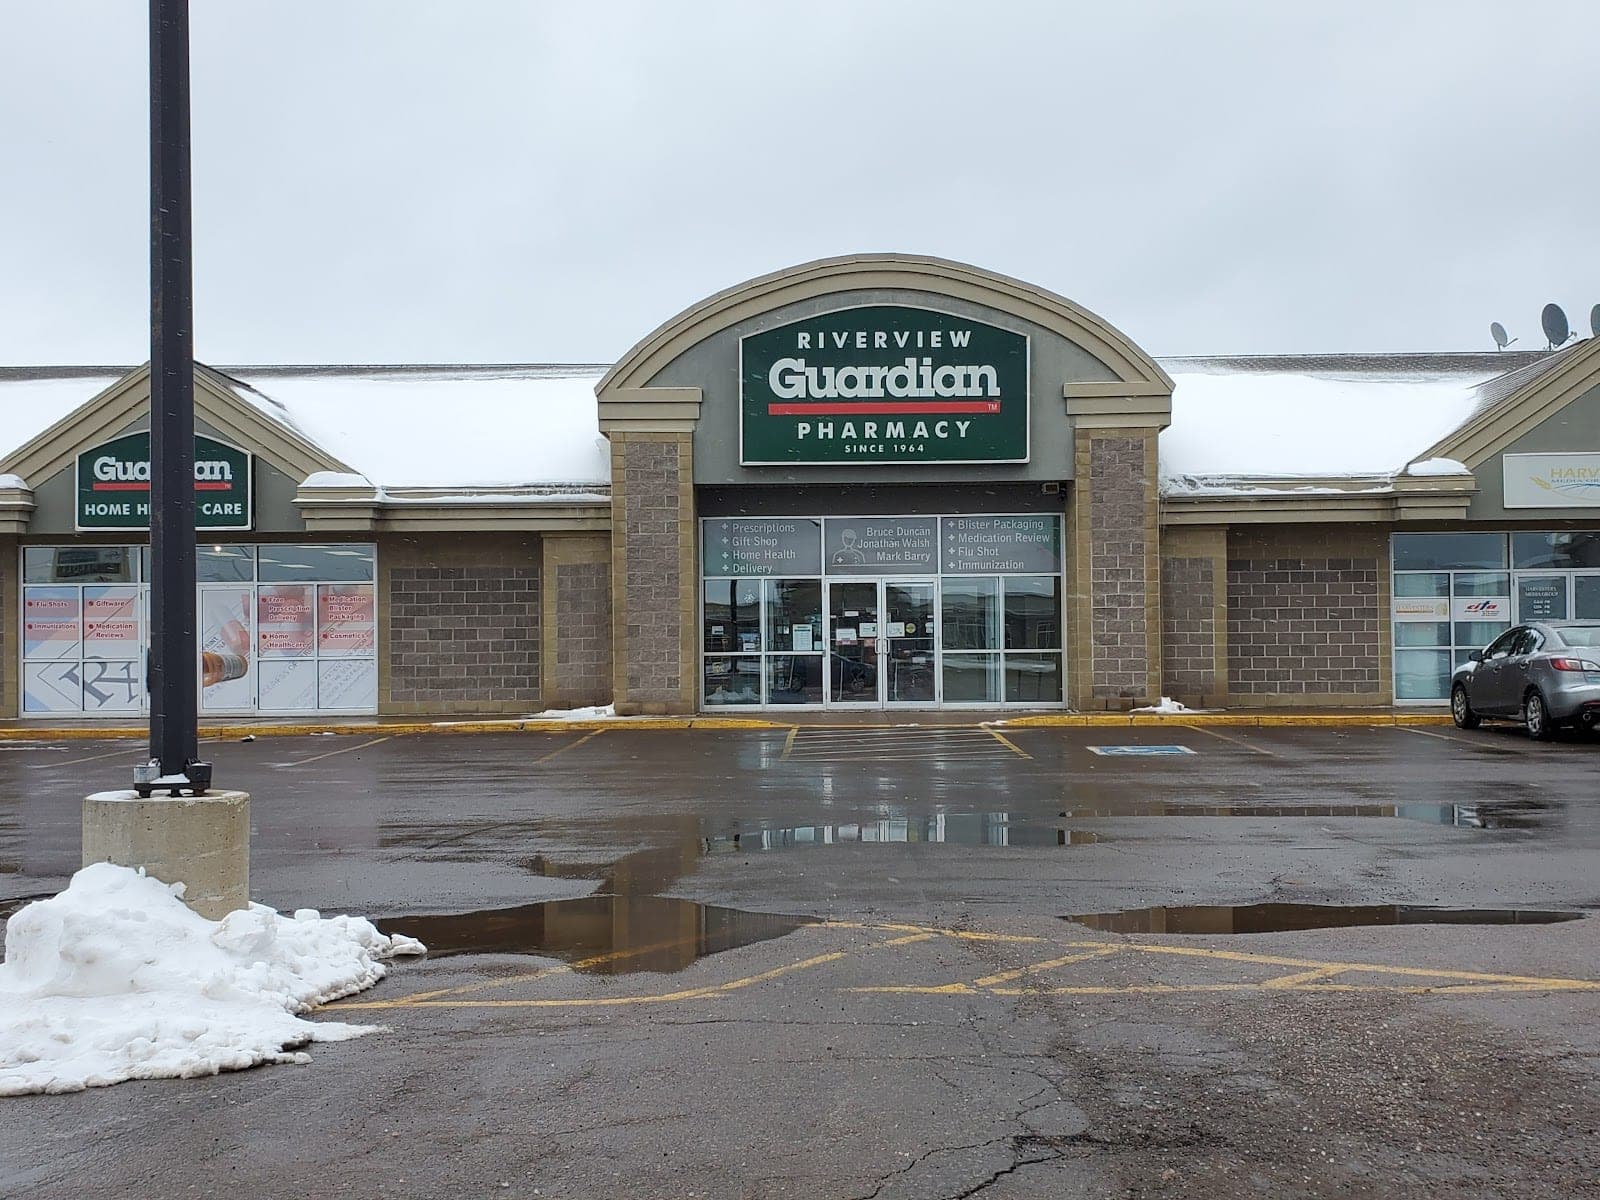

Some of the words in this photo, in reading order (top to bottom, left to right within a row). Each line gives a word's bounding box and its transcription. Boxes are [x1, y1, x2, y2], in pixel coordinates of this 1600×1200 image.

[798, 331, 971, 349] RIVERVIEW
[769, 357, 1000, 398] Guardian
[798, 421, 971, 439] PHARMACY
[845, 444, 885, 453] SINCE
[893, 444, 925, 453] 1964
[93, 456, 232, 481] Guaan
[85, 504, 130, 515] HOME
[202, 503, 242, 515] CARE
[732, 523, 795, 534] Prescriptions
[958, 520, 989, 530] Blister
[993, 519, 1044, 530] Packaging
[866, 527, 894, 537] Bruce
[897, 526, 931, 536] Duncan
[732, 536, 751, 546] Gift
[753, 536, 778, 547] Shop
[958, 533, 1012, 543] Medication
[1015, 532, 1050, 542] Review
[857, 539, 900, 549] Jonathan
[902, 538, 930, 548] Walsh
[733, 550, 761, 560] Home
[764, 549, 796, 559] Health
[876, 551, 902, 561] Mark
[904, 551, 931, 562] Barry
[958, 547, 974, 556] Flu
[977, 546, 999, 556] Shot
[733, 563, 773, 574] Delivery
[958, 560, 1025, 570] Immunization
